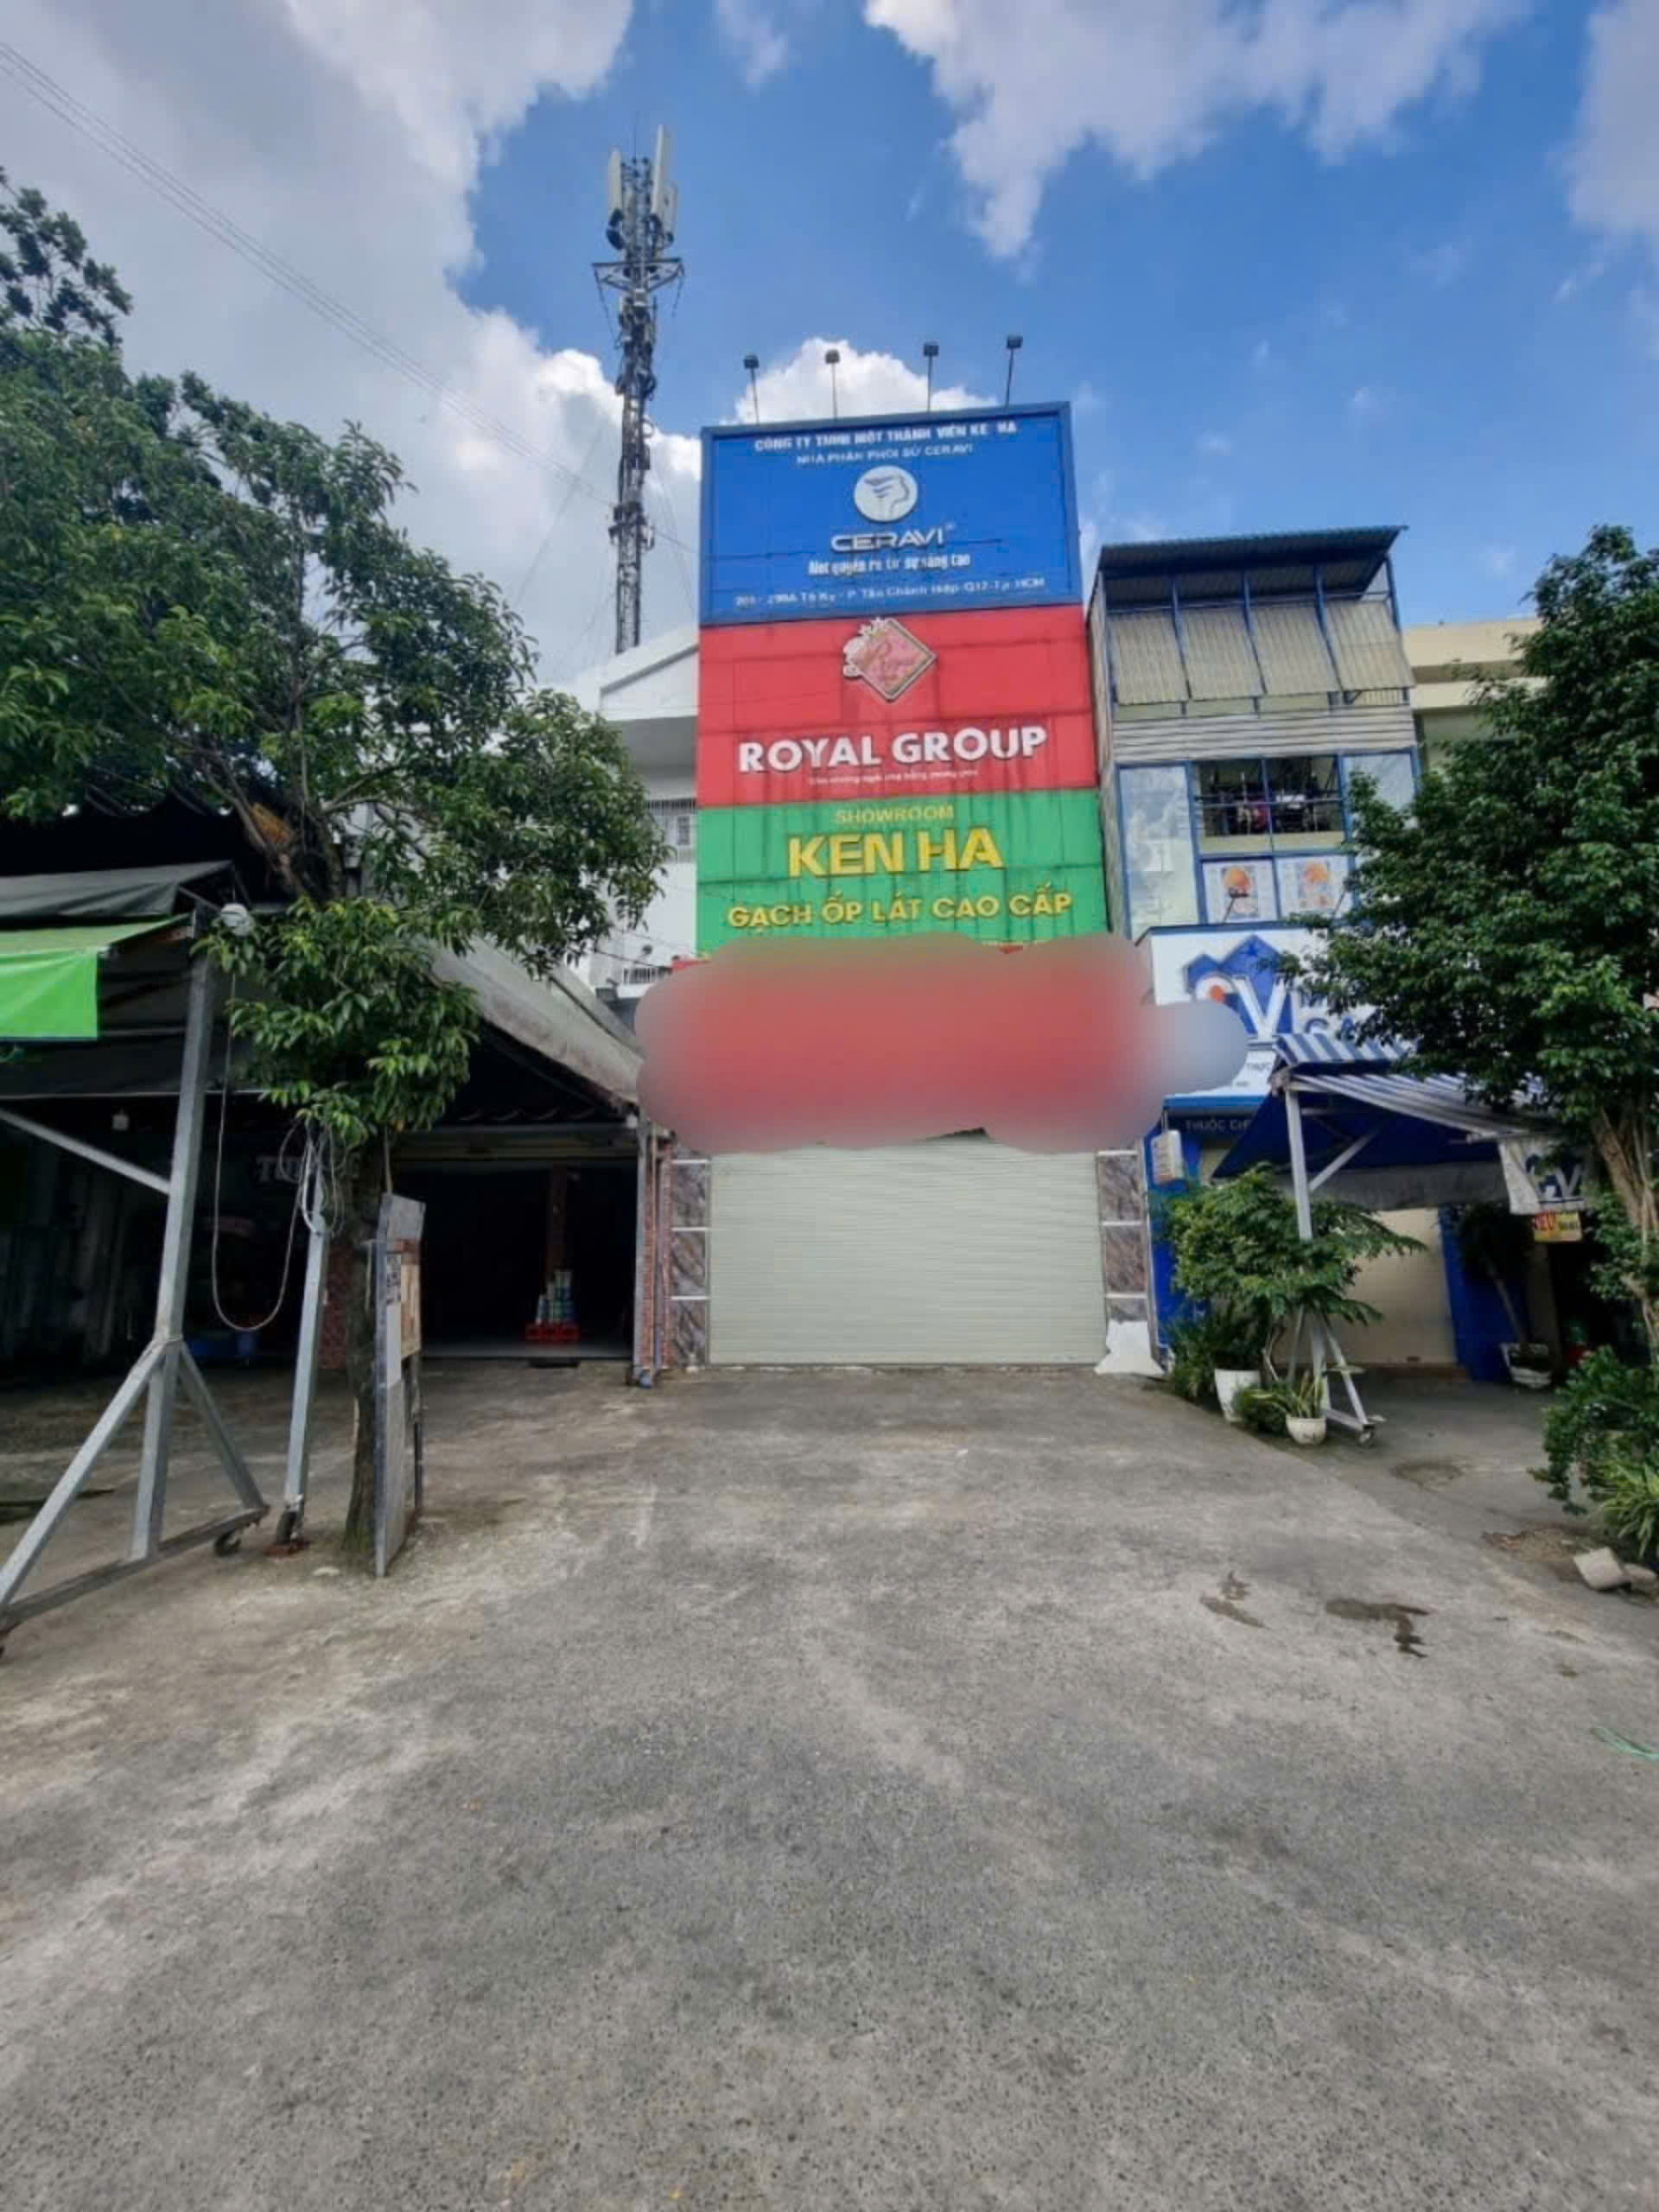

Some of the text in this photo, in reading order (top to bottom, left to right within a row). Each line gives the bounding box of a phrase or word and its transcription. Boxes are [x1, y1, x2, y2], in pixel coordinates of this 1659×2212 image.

[830, 528, 944, 552] CERAVI
[739, 726, 1047, 773] ROYAL GROUP
[834, 804, 955, 824] SHOWROOM
[788, 827, 1003, 878] KEN HA
[727, 882, 1072, 933] GẠCH ỐP LÁT CAO CẤP
